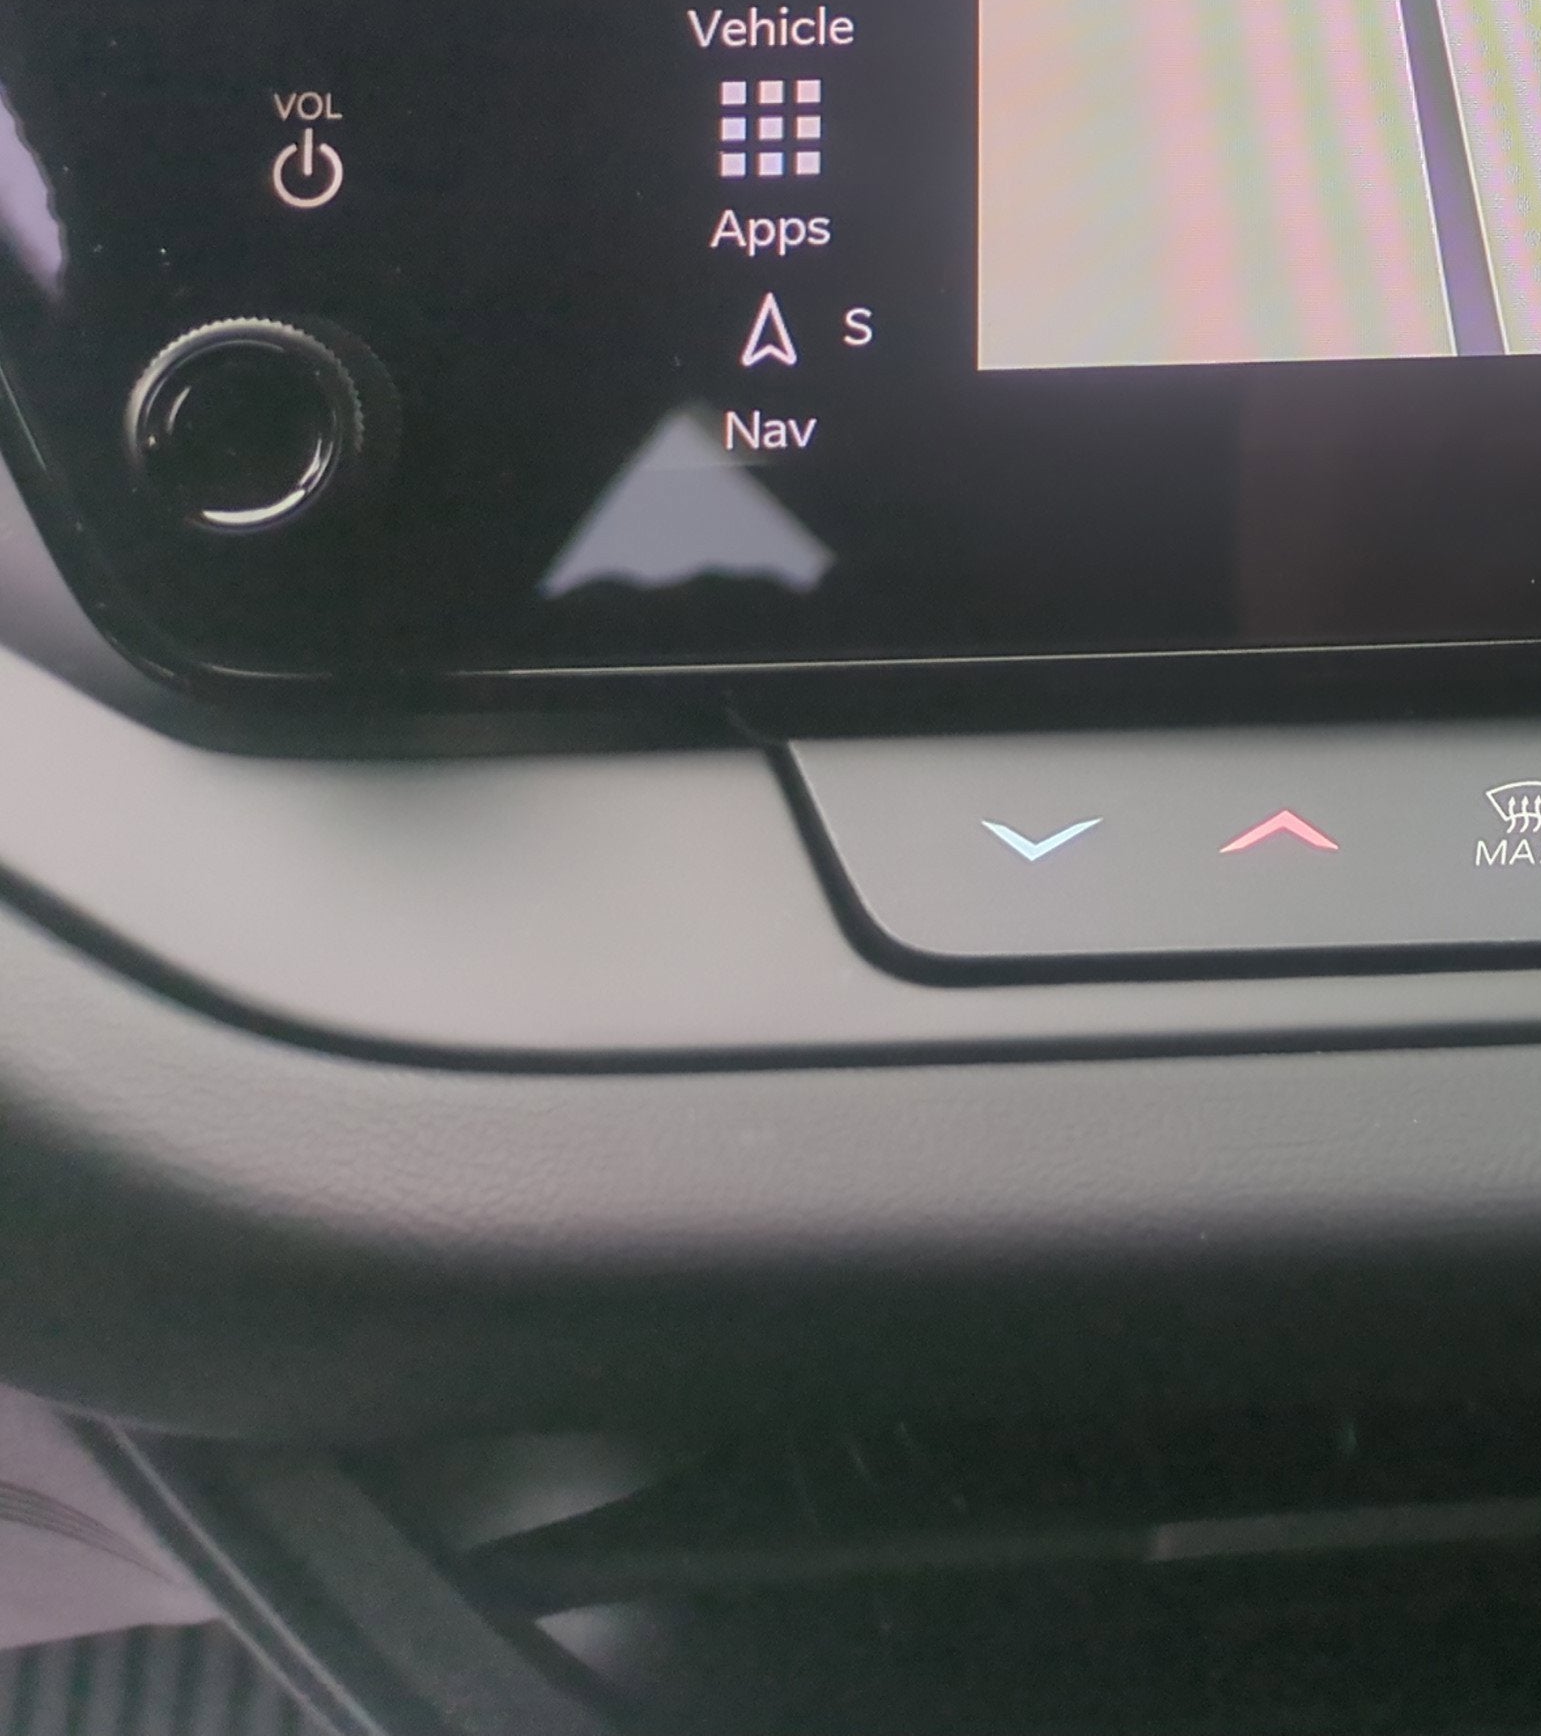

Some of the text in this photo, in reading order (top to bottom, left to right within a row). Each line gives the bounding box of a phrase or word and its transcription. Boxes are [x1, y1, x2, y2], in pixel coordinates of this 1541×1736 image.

[687, 6, 855, 48] Vehicle
[273, 93, 343, 121] VOL
[710, 209, 832, 256] Apps
[843, 306, 874, 346] S
[724, 410, 817, 450] Nav
